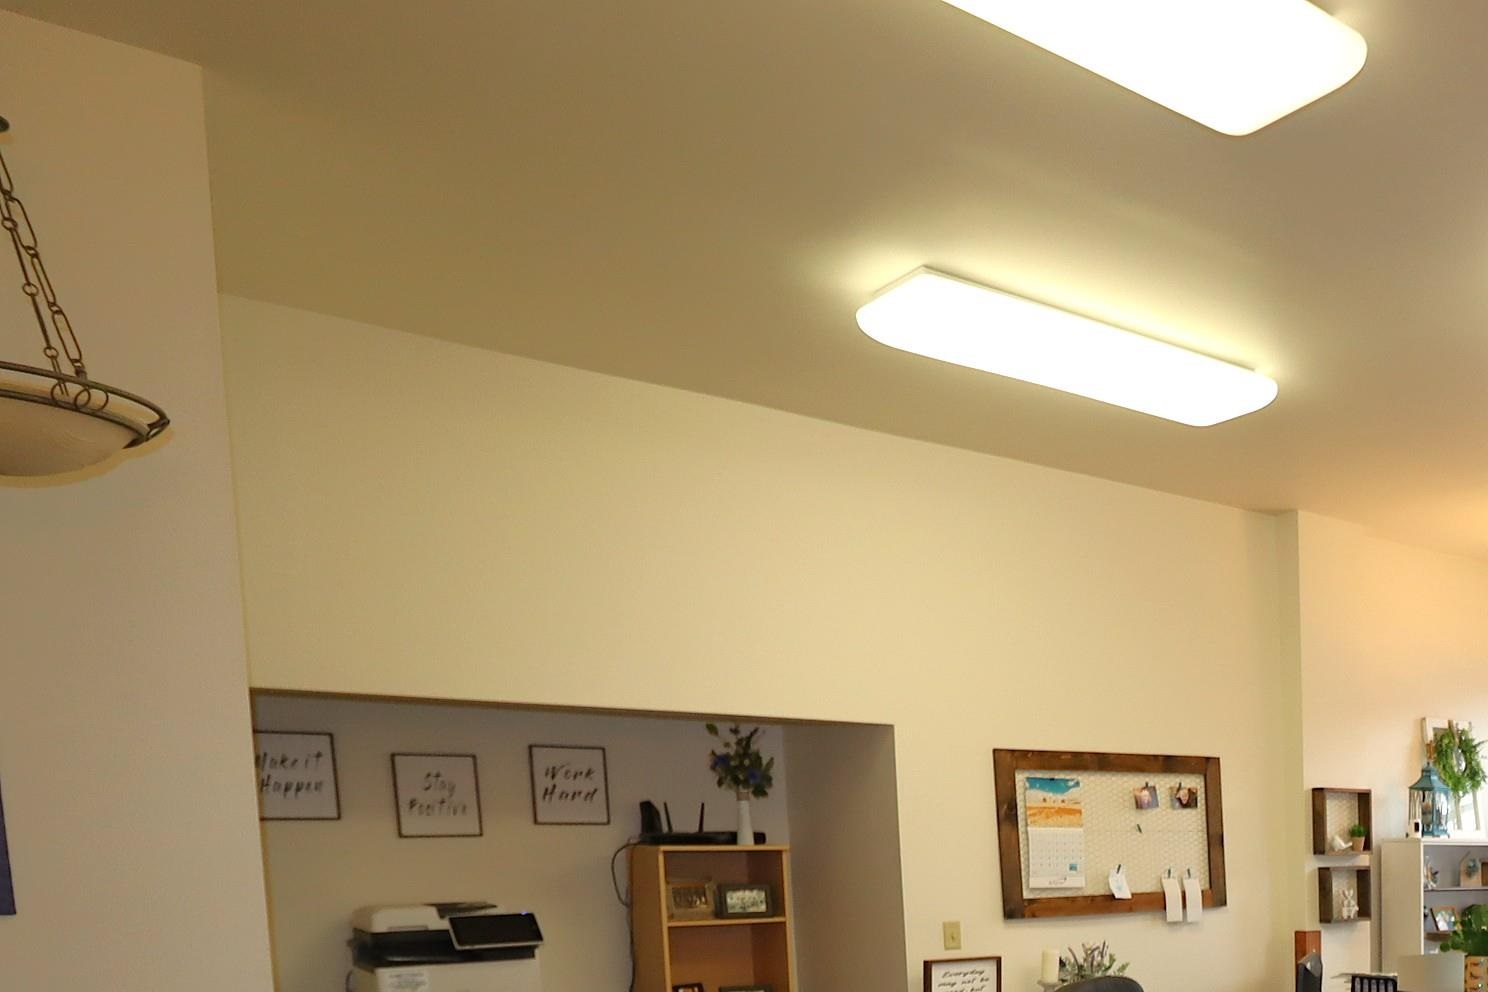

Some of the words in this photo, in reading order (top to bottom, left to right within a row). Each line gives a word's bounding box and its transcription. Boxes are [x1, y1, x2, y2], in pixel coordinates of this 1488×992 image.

[544, 762, 596, 780] Work
[260, 773, 323, 799] Happen
[423, 771, 457, 799] Stay
[542, 783, 598, 803] Hard
[408, 798, 468, 817] Positive
